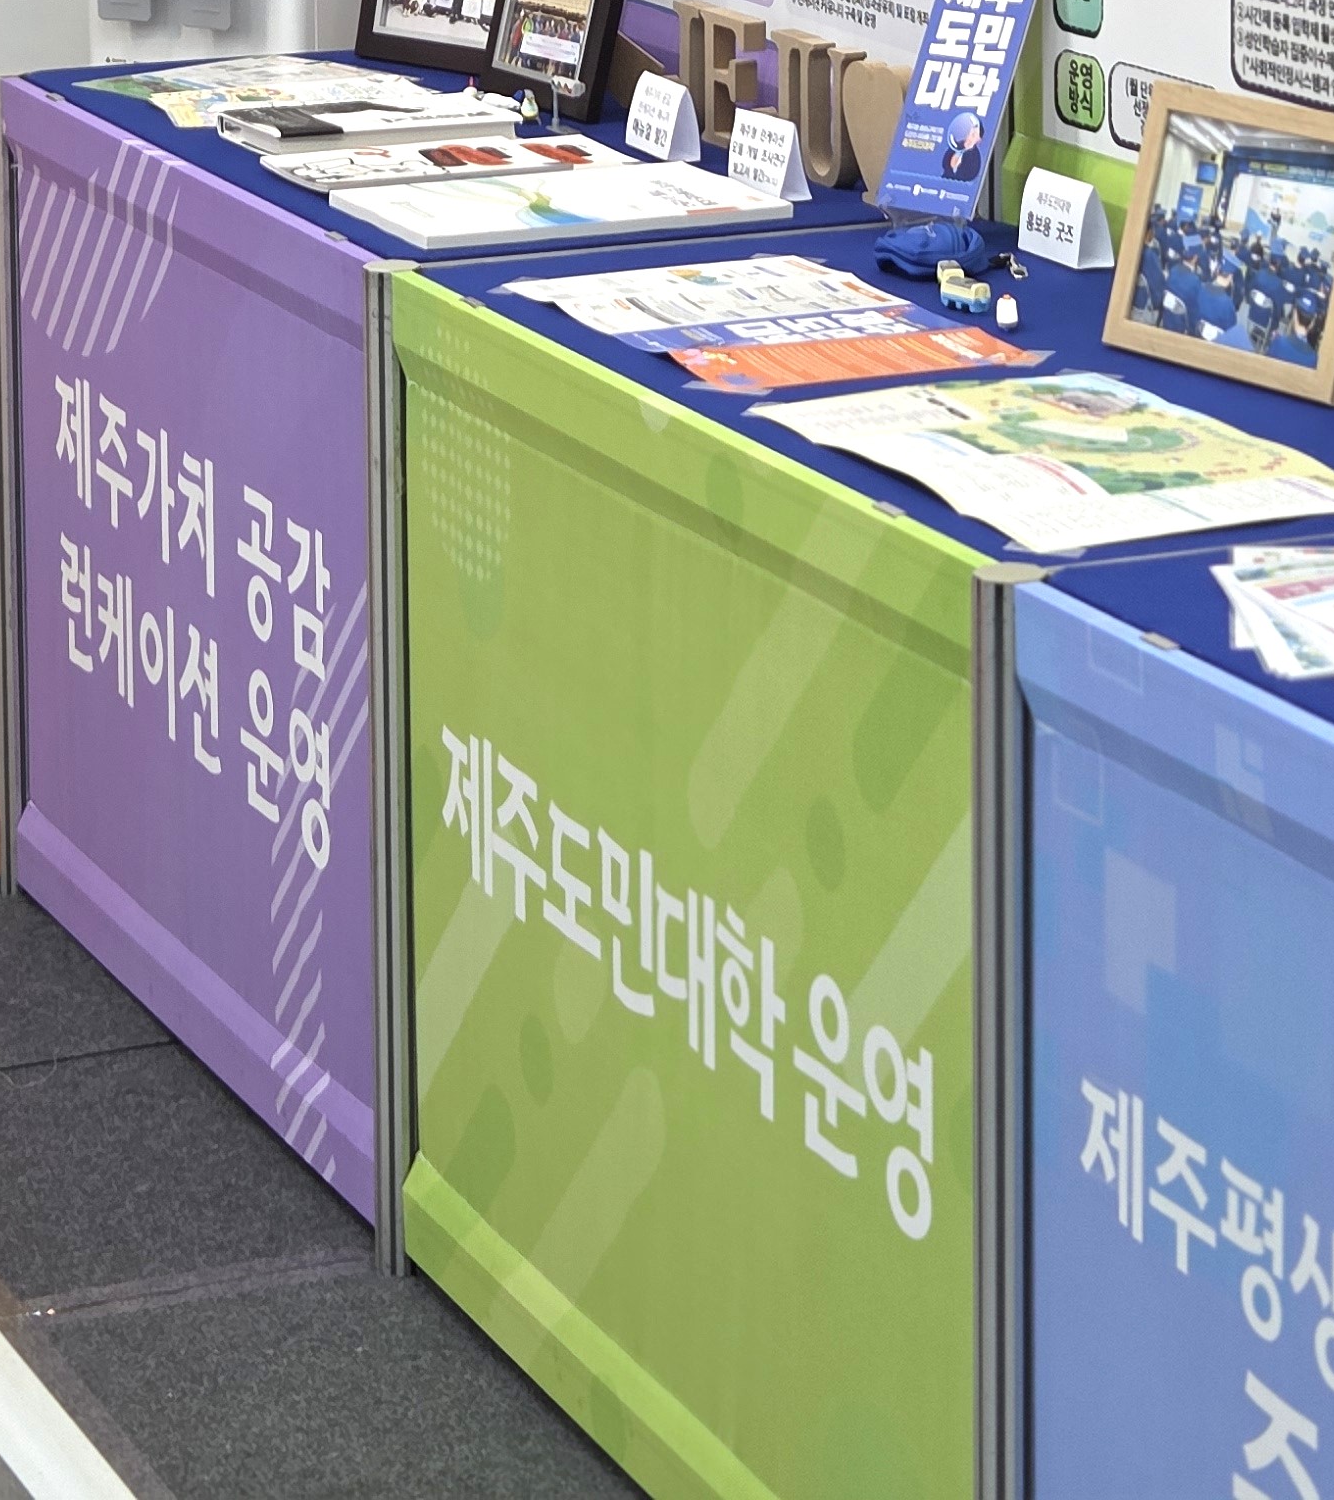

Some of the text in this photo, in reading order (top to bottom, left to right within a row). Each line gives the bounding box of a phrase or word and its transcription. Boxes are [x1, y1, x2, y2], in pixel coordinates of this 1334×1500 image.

[914, 59, 1000, 118] 대학
[929, 9, 1015, 65] 도민
[1026, 210, 1074, 244] 홍보용 굿즈
[55, 375, 332, 681] 제주가치 공감
[59, 533, 333, 870] 런케이션 운영
[441, 725, 936, 1241] 제주도민대학 운영
